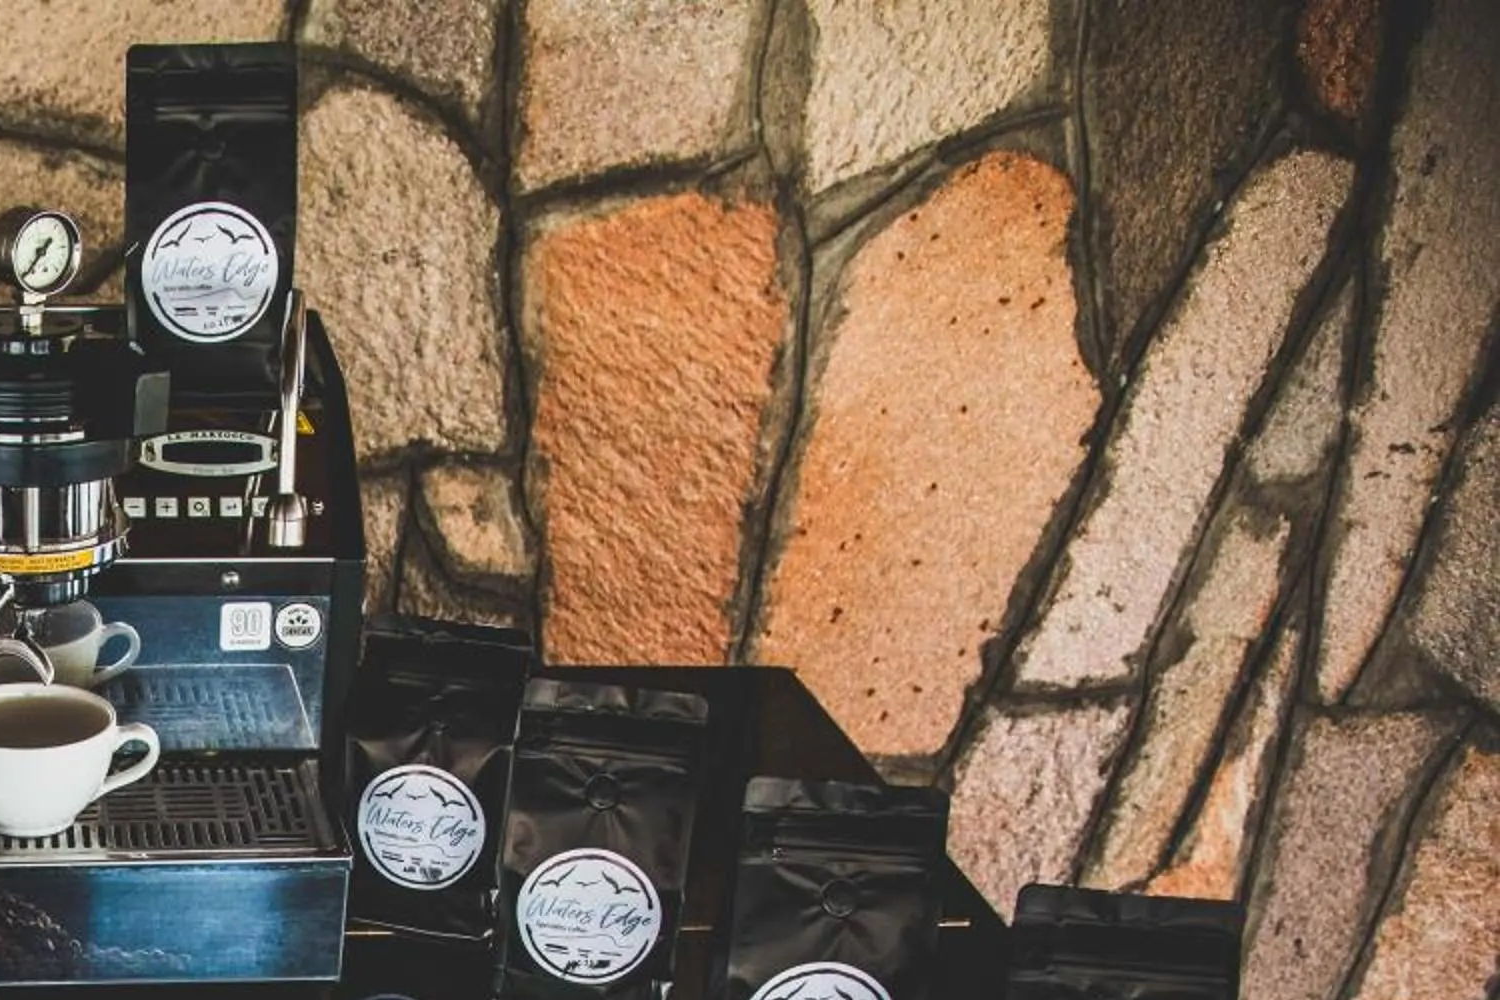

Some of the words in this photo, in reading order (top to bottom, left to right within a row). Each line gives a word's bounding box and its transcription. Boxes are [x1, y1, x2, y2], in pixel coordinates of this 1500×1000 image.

[152, 255, 214, 284] Waters
[223, 251, 269, 287] Edge
[366, 801, 424, 833] Waters
[429, 815, 477, 847] Edge
[525, 894, 596, 924] Waters
[600, 902, 651, 937] Edge
